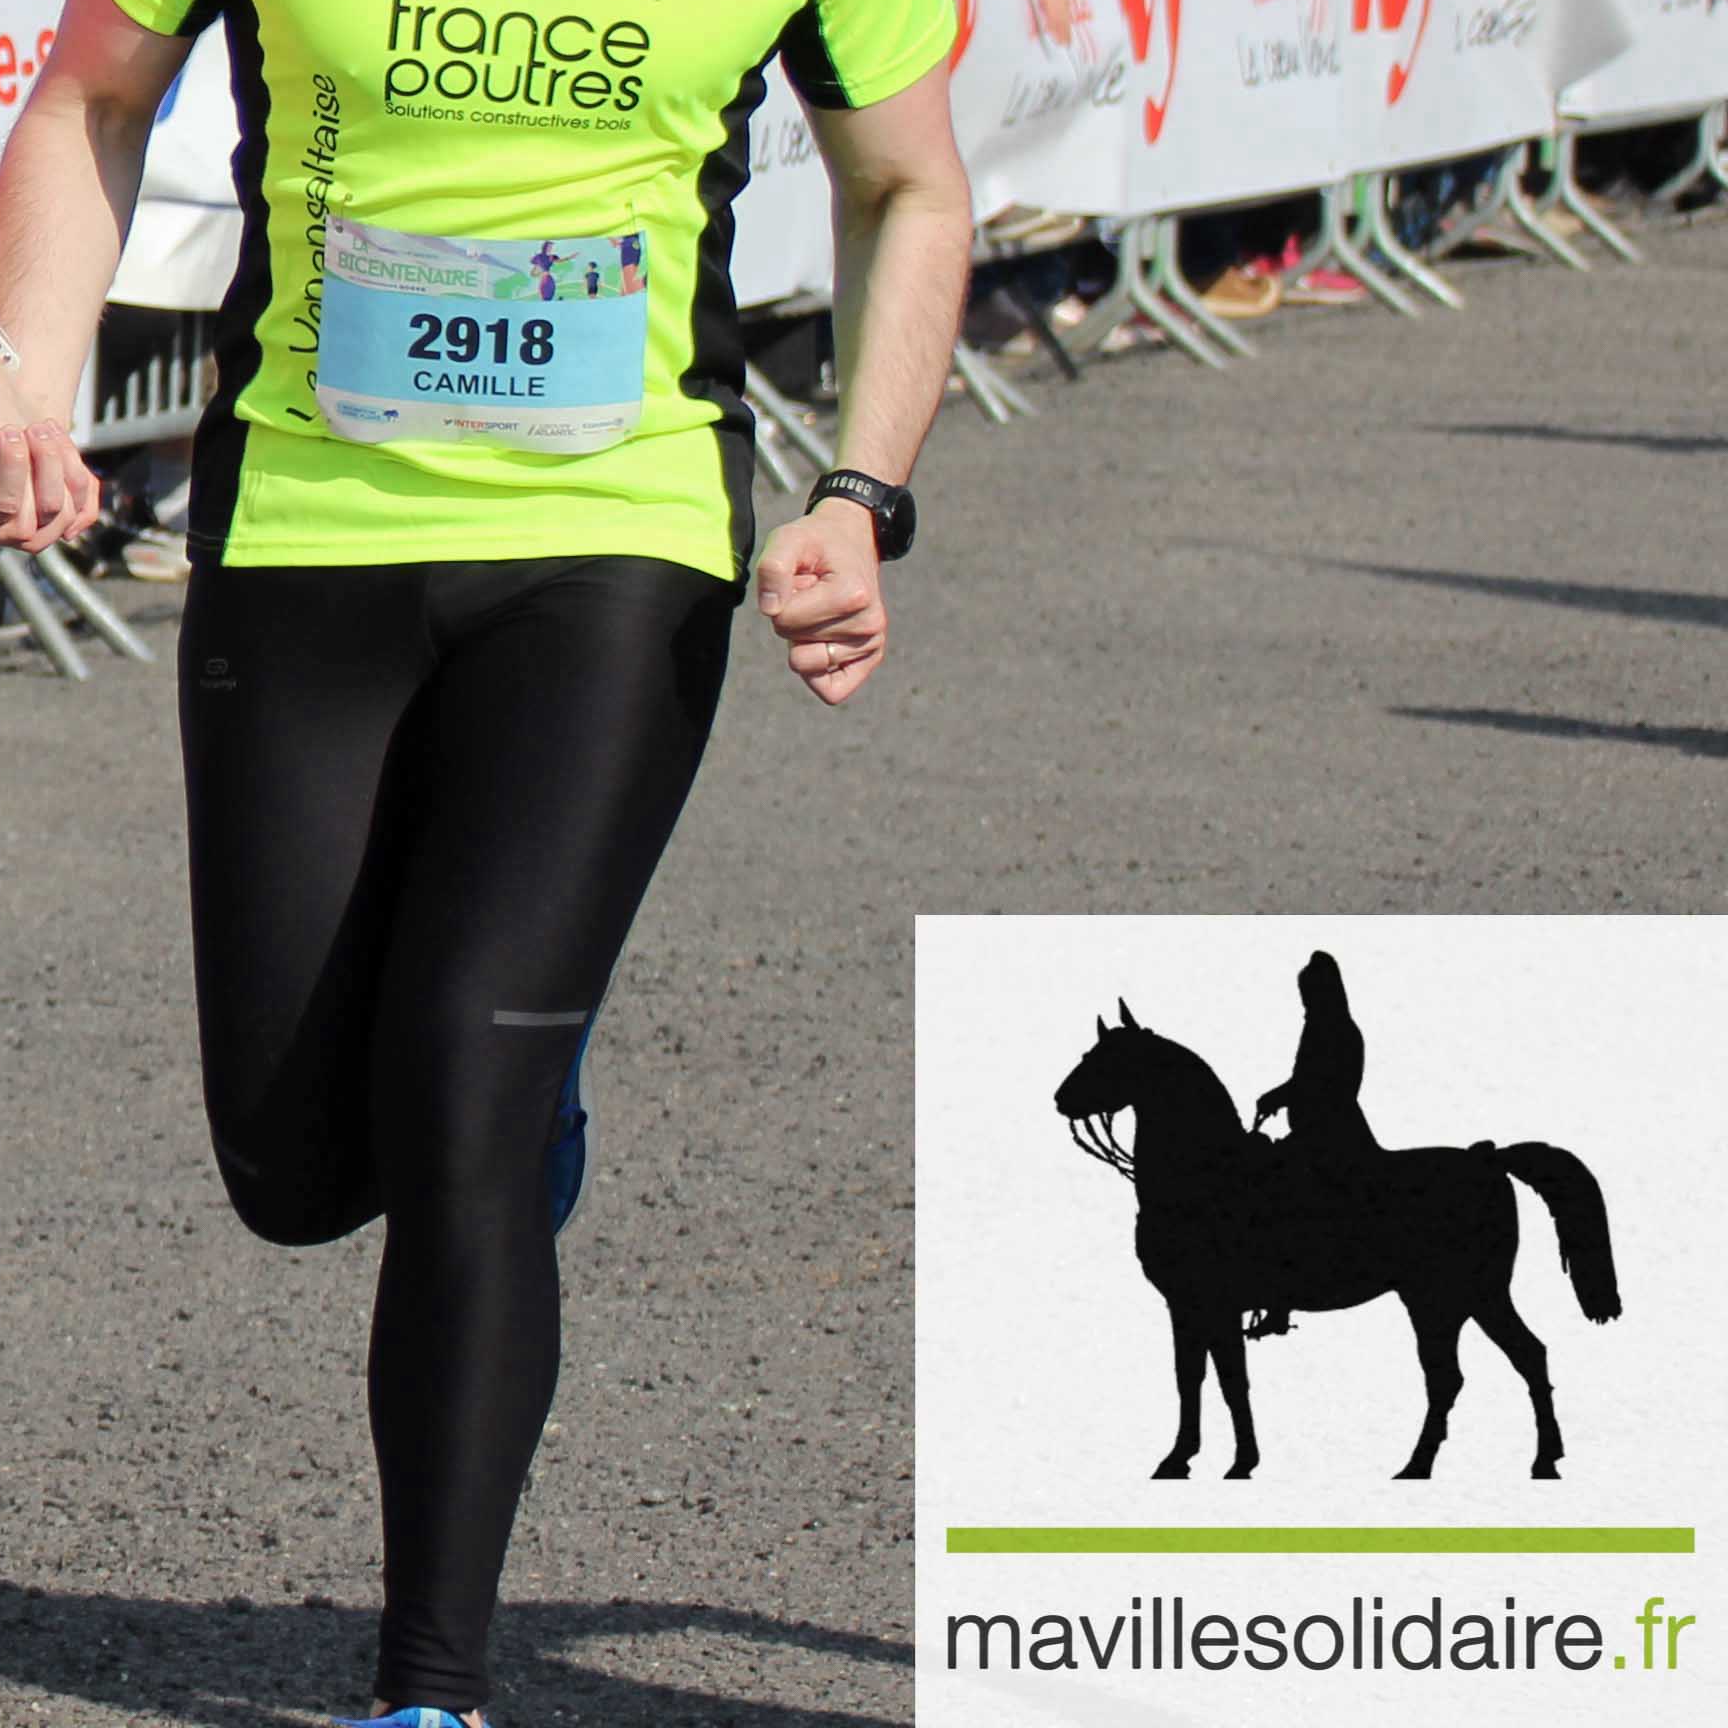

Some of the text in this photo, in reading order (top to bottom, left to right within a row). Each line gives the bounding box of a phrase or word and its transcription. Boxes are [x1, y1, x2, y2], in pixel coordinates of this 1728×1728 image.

[385, 57, 644, 112] poutres
[385, 102, 632, 132] Solutions constructives bois
[337, 251, 479, 288] BICENTENAIRE
[407, 313, 554, 366] 2918
[413, 370, 547, 398] CAMILLE
